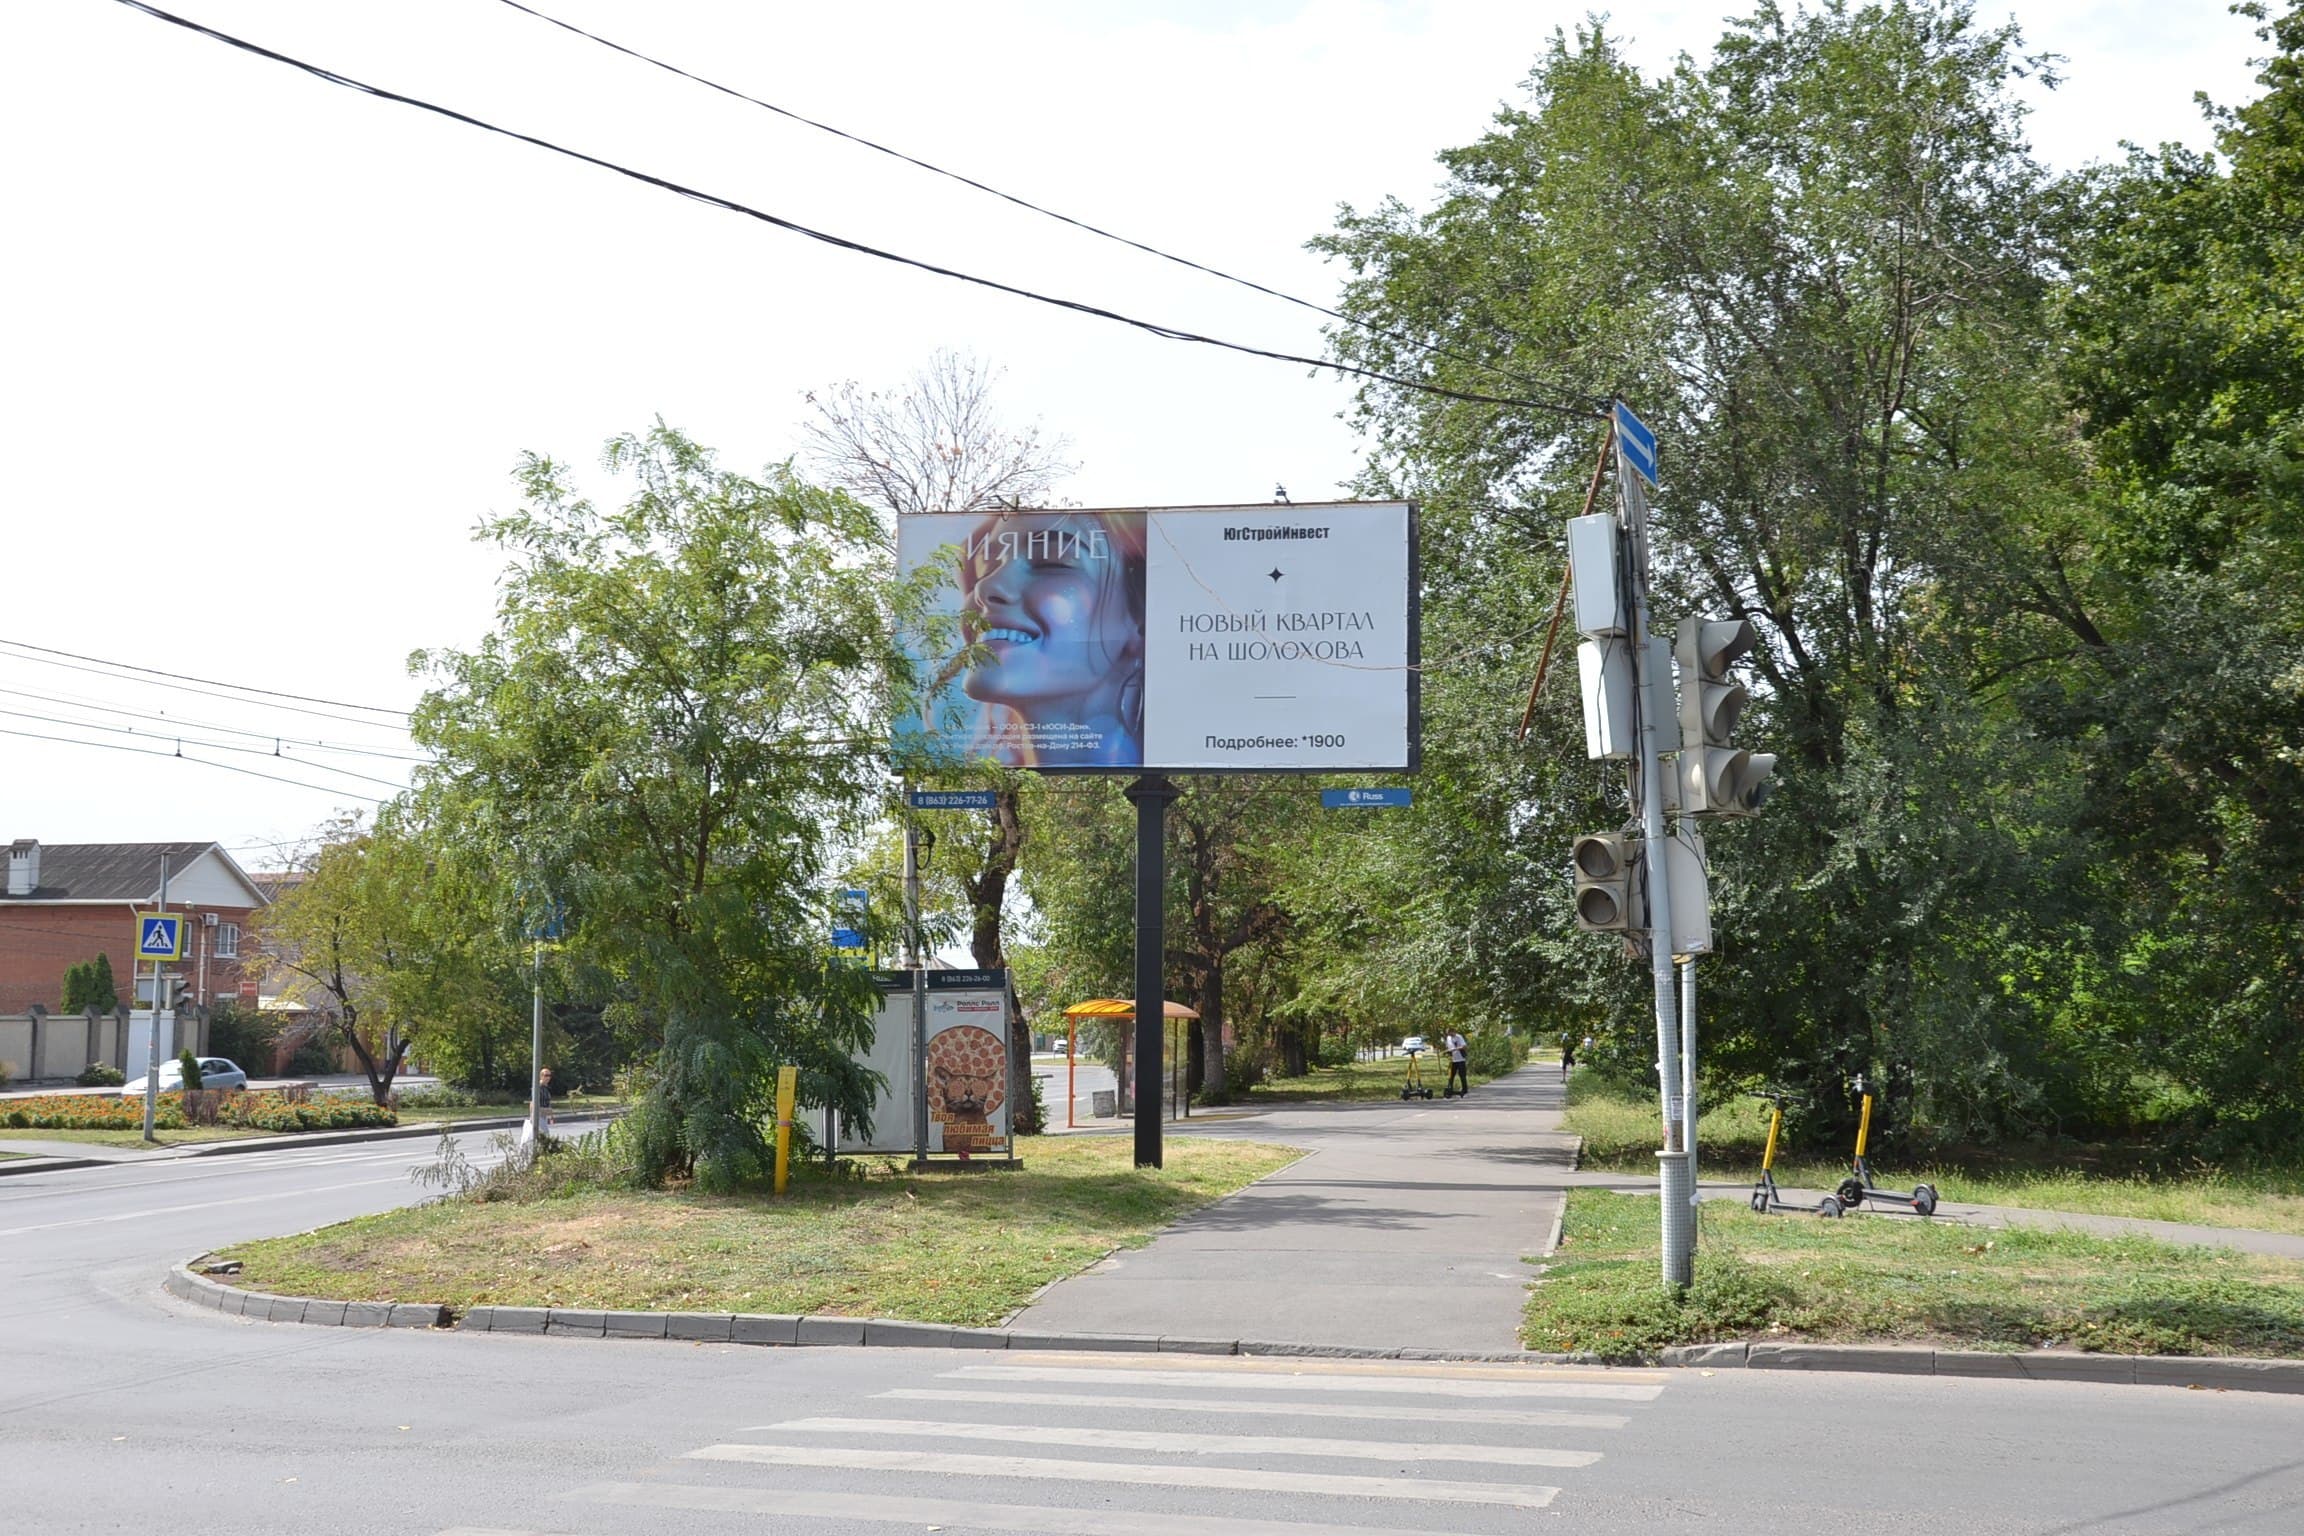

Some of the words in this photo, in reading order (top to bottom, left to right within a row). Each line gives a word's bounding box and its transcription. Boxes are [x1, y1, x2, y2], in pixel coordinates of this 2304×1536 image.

[1223, 525, 1331, 542] ЮгСтройИнвест
[1179, 608, 1267, 633] НОВЫЙ
[1276, 611, 1375, 632] КВАРТАЛ
[1189, 642, 1219, 661] НА
[1228, 640, 1365, 661] ШОЛОХОВА
[1205, 735, 1299, 750] Подробнее:
[918, 796, 924, 805] 8
[925, 796, 946, 806] (863)
[948, 796, 988, 805] 226-77-26
[1362, 792, 1384, 800] Russ
[943, 1122, 995, 1134] любимая
